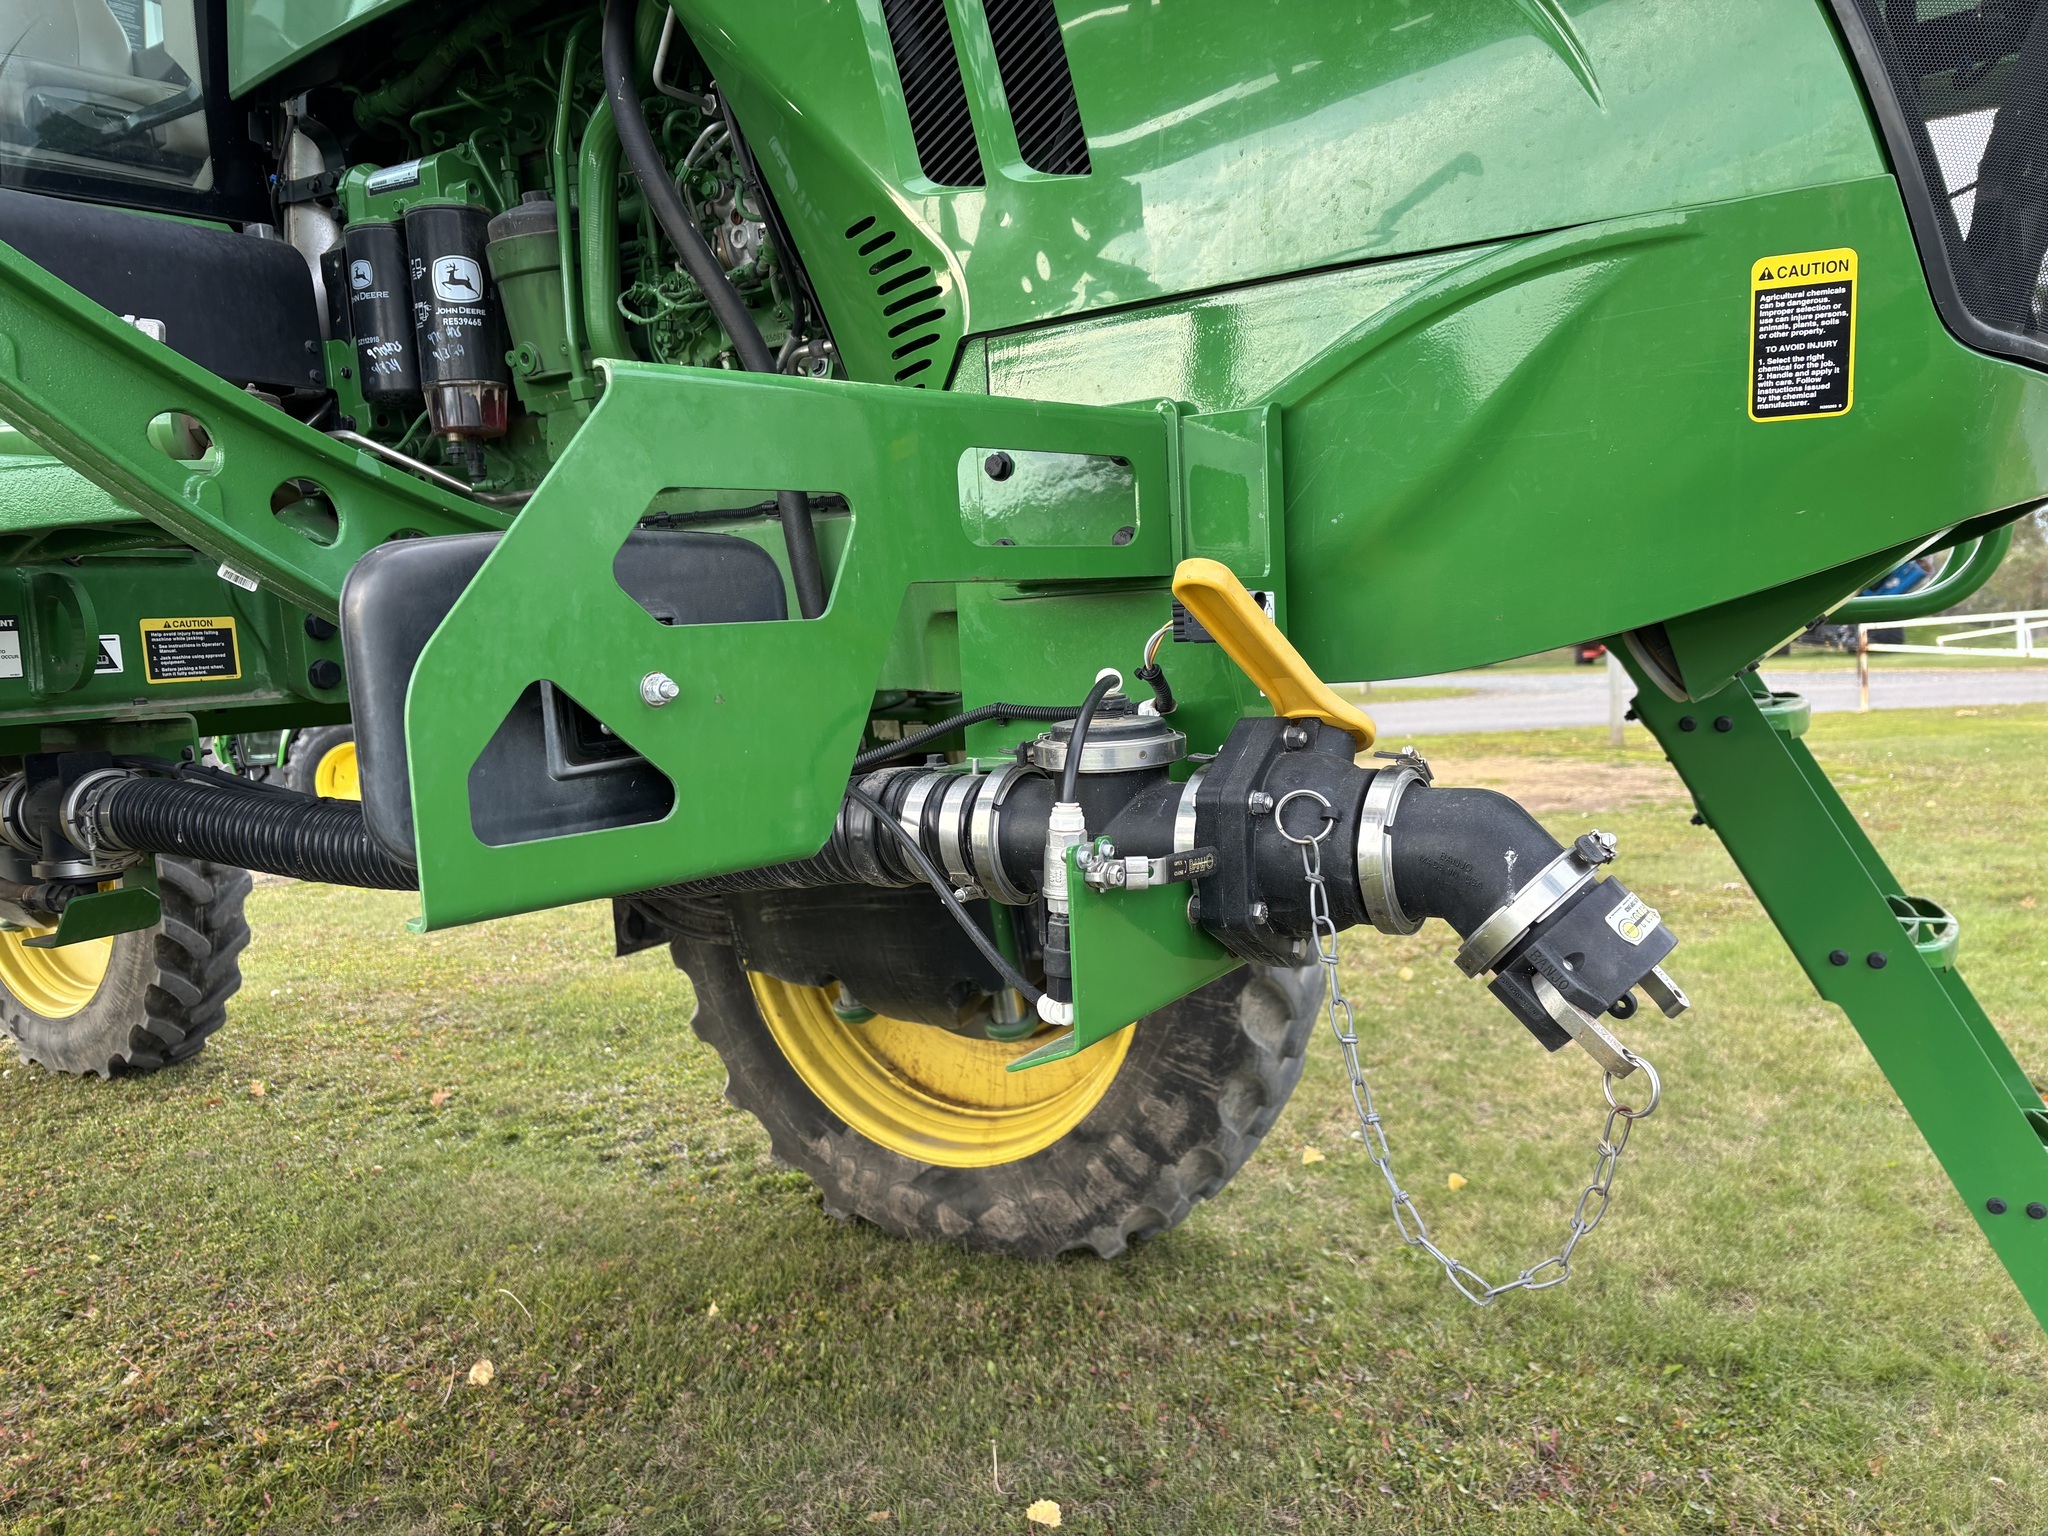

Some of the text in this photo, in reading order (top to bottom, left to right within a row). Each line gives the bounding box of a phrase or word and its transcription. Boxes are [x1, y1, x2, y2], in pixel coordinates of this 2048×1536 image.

[1777, 259, 1849, 279] CAUTION
[360, 291, 389, 300] DEERE
[1760, 287, 1846, 302] Agricultural chemicals
[1787, 297, 1830, 306] dangerous.
[459, 307, 486, 315] DEERE
[1760, 309, 1794, 317] Improper
[1796, 304, 1831, 313] selection
[1791, 313, 1813, 322] injure
[1815, 310, 1848, 320] persons,
[443, 318, 482, 326] RE539465
[1759, 323, 1791, 331] animals,
[1769, 330, 1789, 338] other
[1791, 328, 1826, 337] property.
[1779, 343, 1805, 352] AVOID
[1807, 340, 1838, 349] INJURY
[1767, 356, 1790, 365] Select
[1806, 353, 1825, 361] right
[1758, 364, 1792, 373] chemical
[1821, 360, 1835, 368] job.
[1811, 368, 1832, 376] apply
[1758, 380, 1774, 388] with
[1758, 383, 1830, 395] instructions issued
[1782, 391, 1816, 400] chemical
[1757, 400, 1810, 410] manufacturer.
[1529, 949, 1569, 990] BANJO
